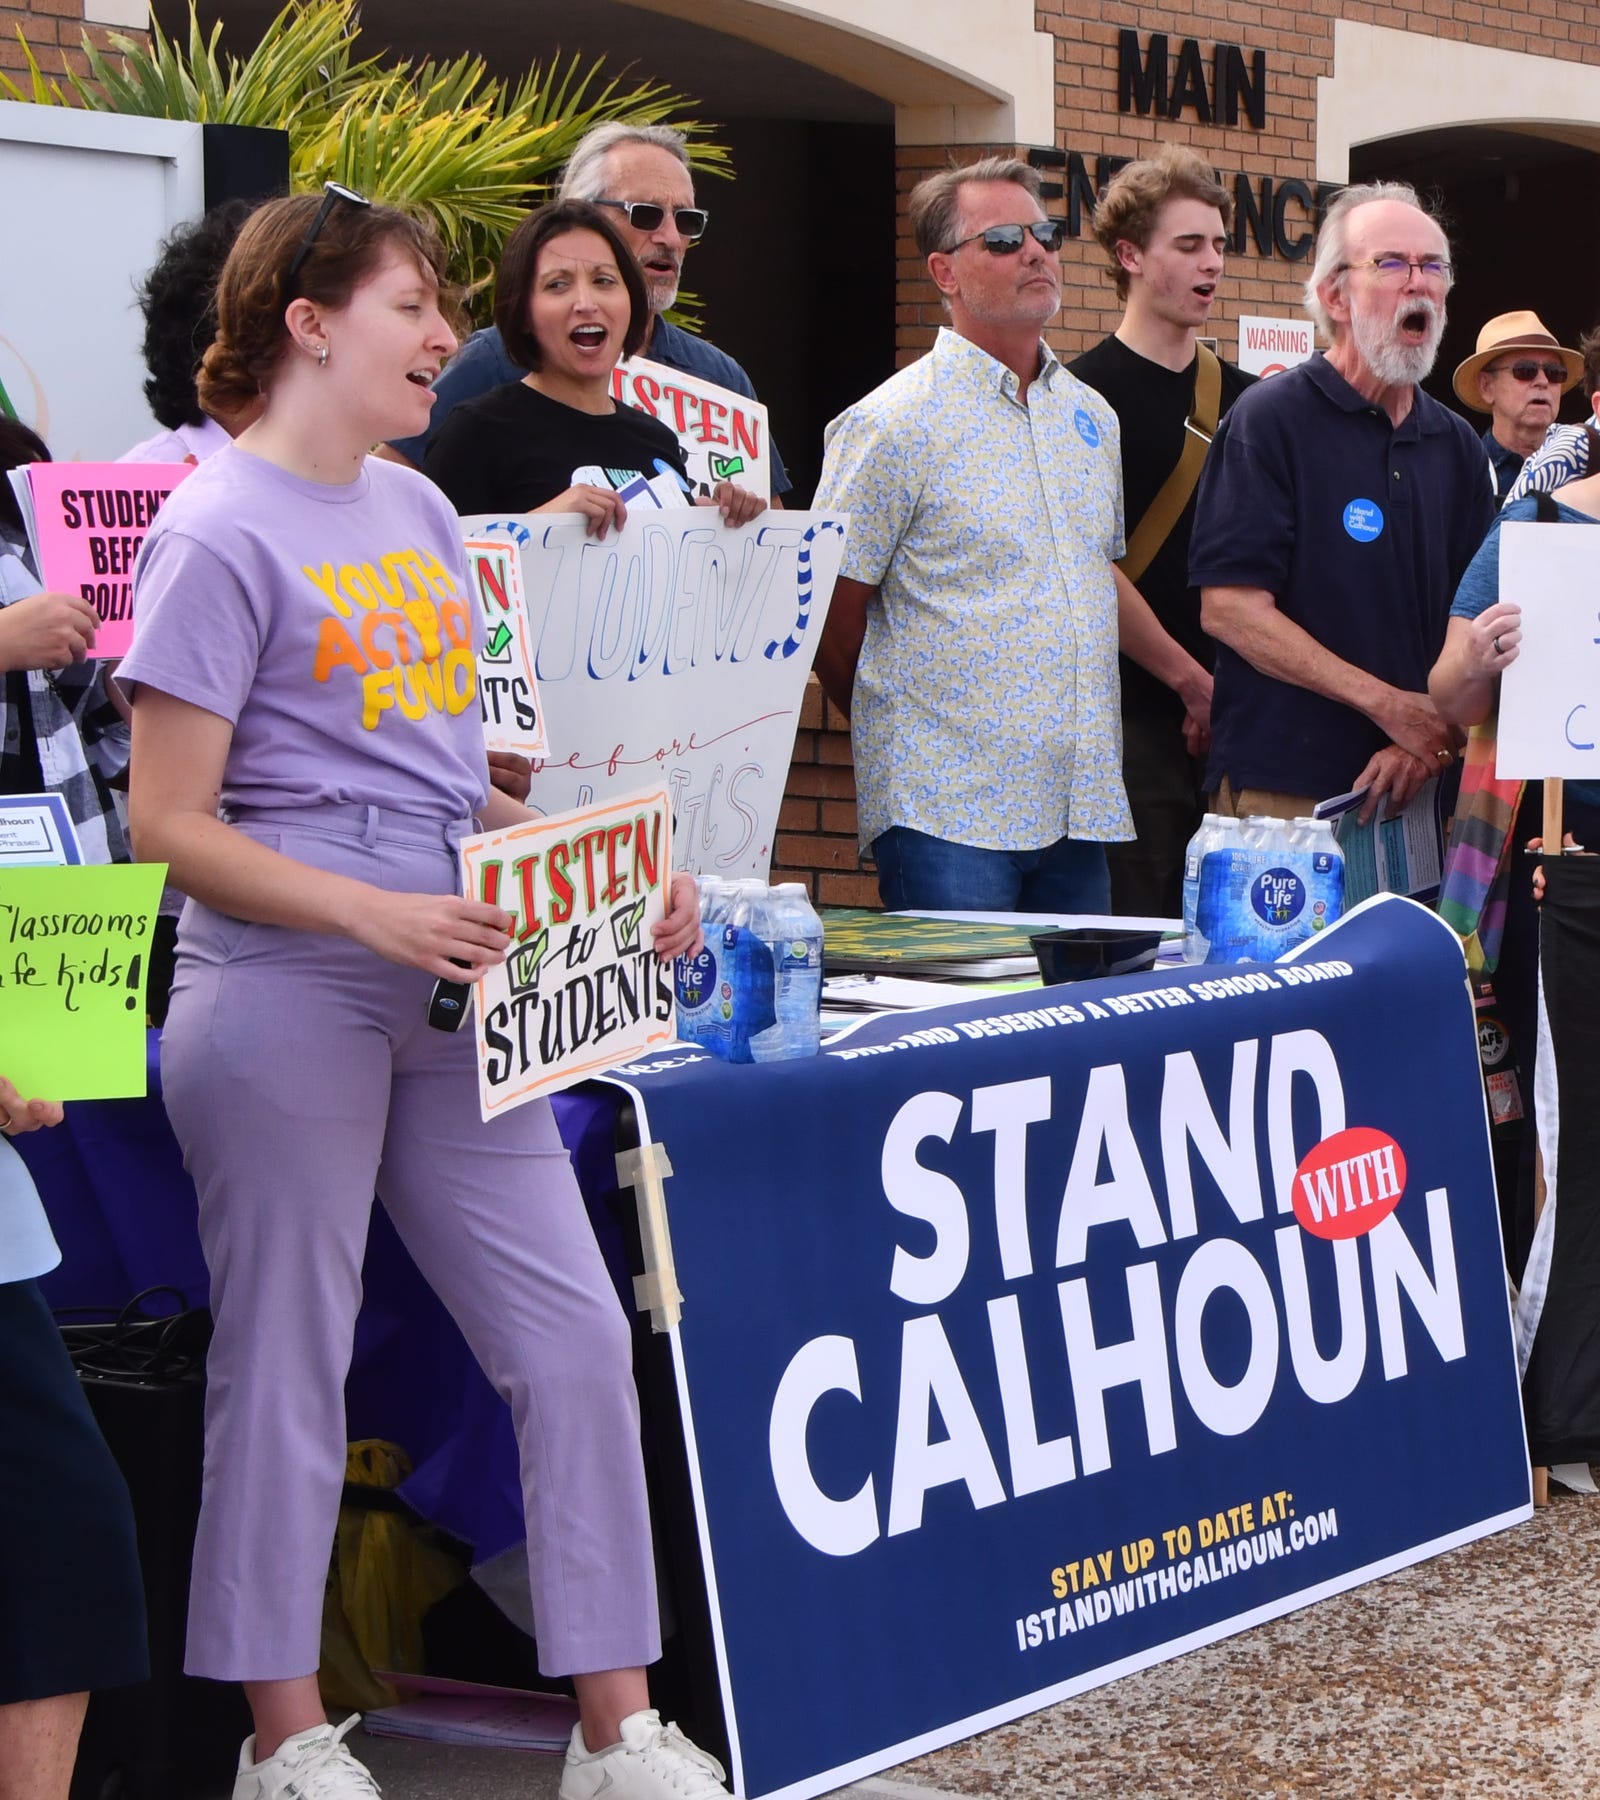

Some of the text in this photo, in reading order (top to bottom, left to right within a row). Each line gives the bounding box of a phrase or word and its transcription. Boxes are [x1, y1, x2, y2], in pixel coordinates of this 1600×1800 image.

[1119, 29, 1266, 129] MAIN
[1029, 149, 1345, 261] ENNC
[1246, 327, 1308, 354] WARNING
[612, 368, 759, 460] ISTEN
[61, 489, 173, 529] STUDEN
[89, 536, 144, 575] BEF
[303, 549, 456, 618] YOUTH
[471, 521, 843, 683] TUDENTS
[479, 810, 661, 946] LISTEN
[1261, 874, 1297, 890] Pure
[1319, 856, 1326, 866] 6
[725, 929, 732, 941] 6
[1264, 889, 1292, 908] Life
[57, 948, 141, 1012] kids!
[543, 919, 606, 972] to
[678, 966, 703, 988] Life
[485, 950, 674, 1086] STUDENTS
[953, 1005, 1085, 1039] DESERVES
[1081, 1001, 1109, 1020] A
[1101, 986, 1195, 1016] BETTER
[1188, 972, 1281, 1001] SCHOOL
[1277, 960, 1354, 986] BOARD
[1480, 1032, 1504, 1046] AFE
[881, 1028, 1346, 1305] STAND
[1301, 1145, 1401, 1223] WITH
[769, 1187, 1466, 1556] CALHOUN
[1015, 1508, 1338, 1651] ISTANDWITHCALHOUN.COM
[1051, 1490, 1295, 1598] STAY UP TO DATE AT:
